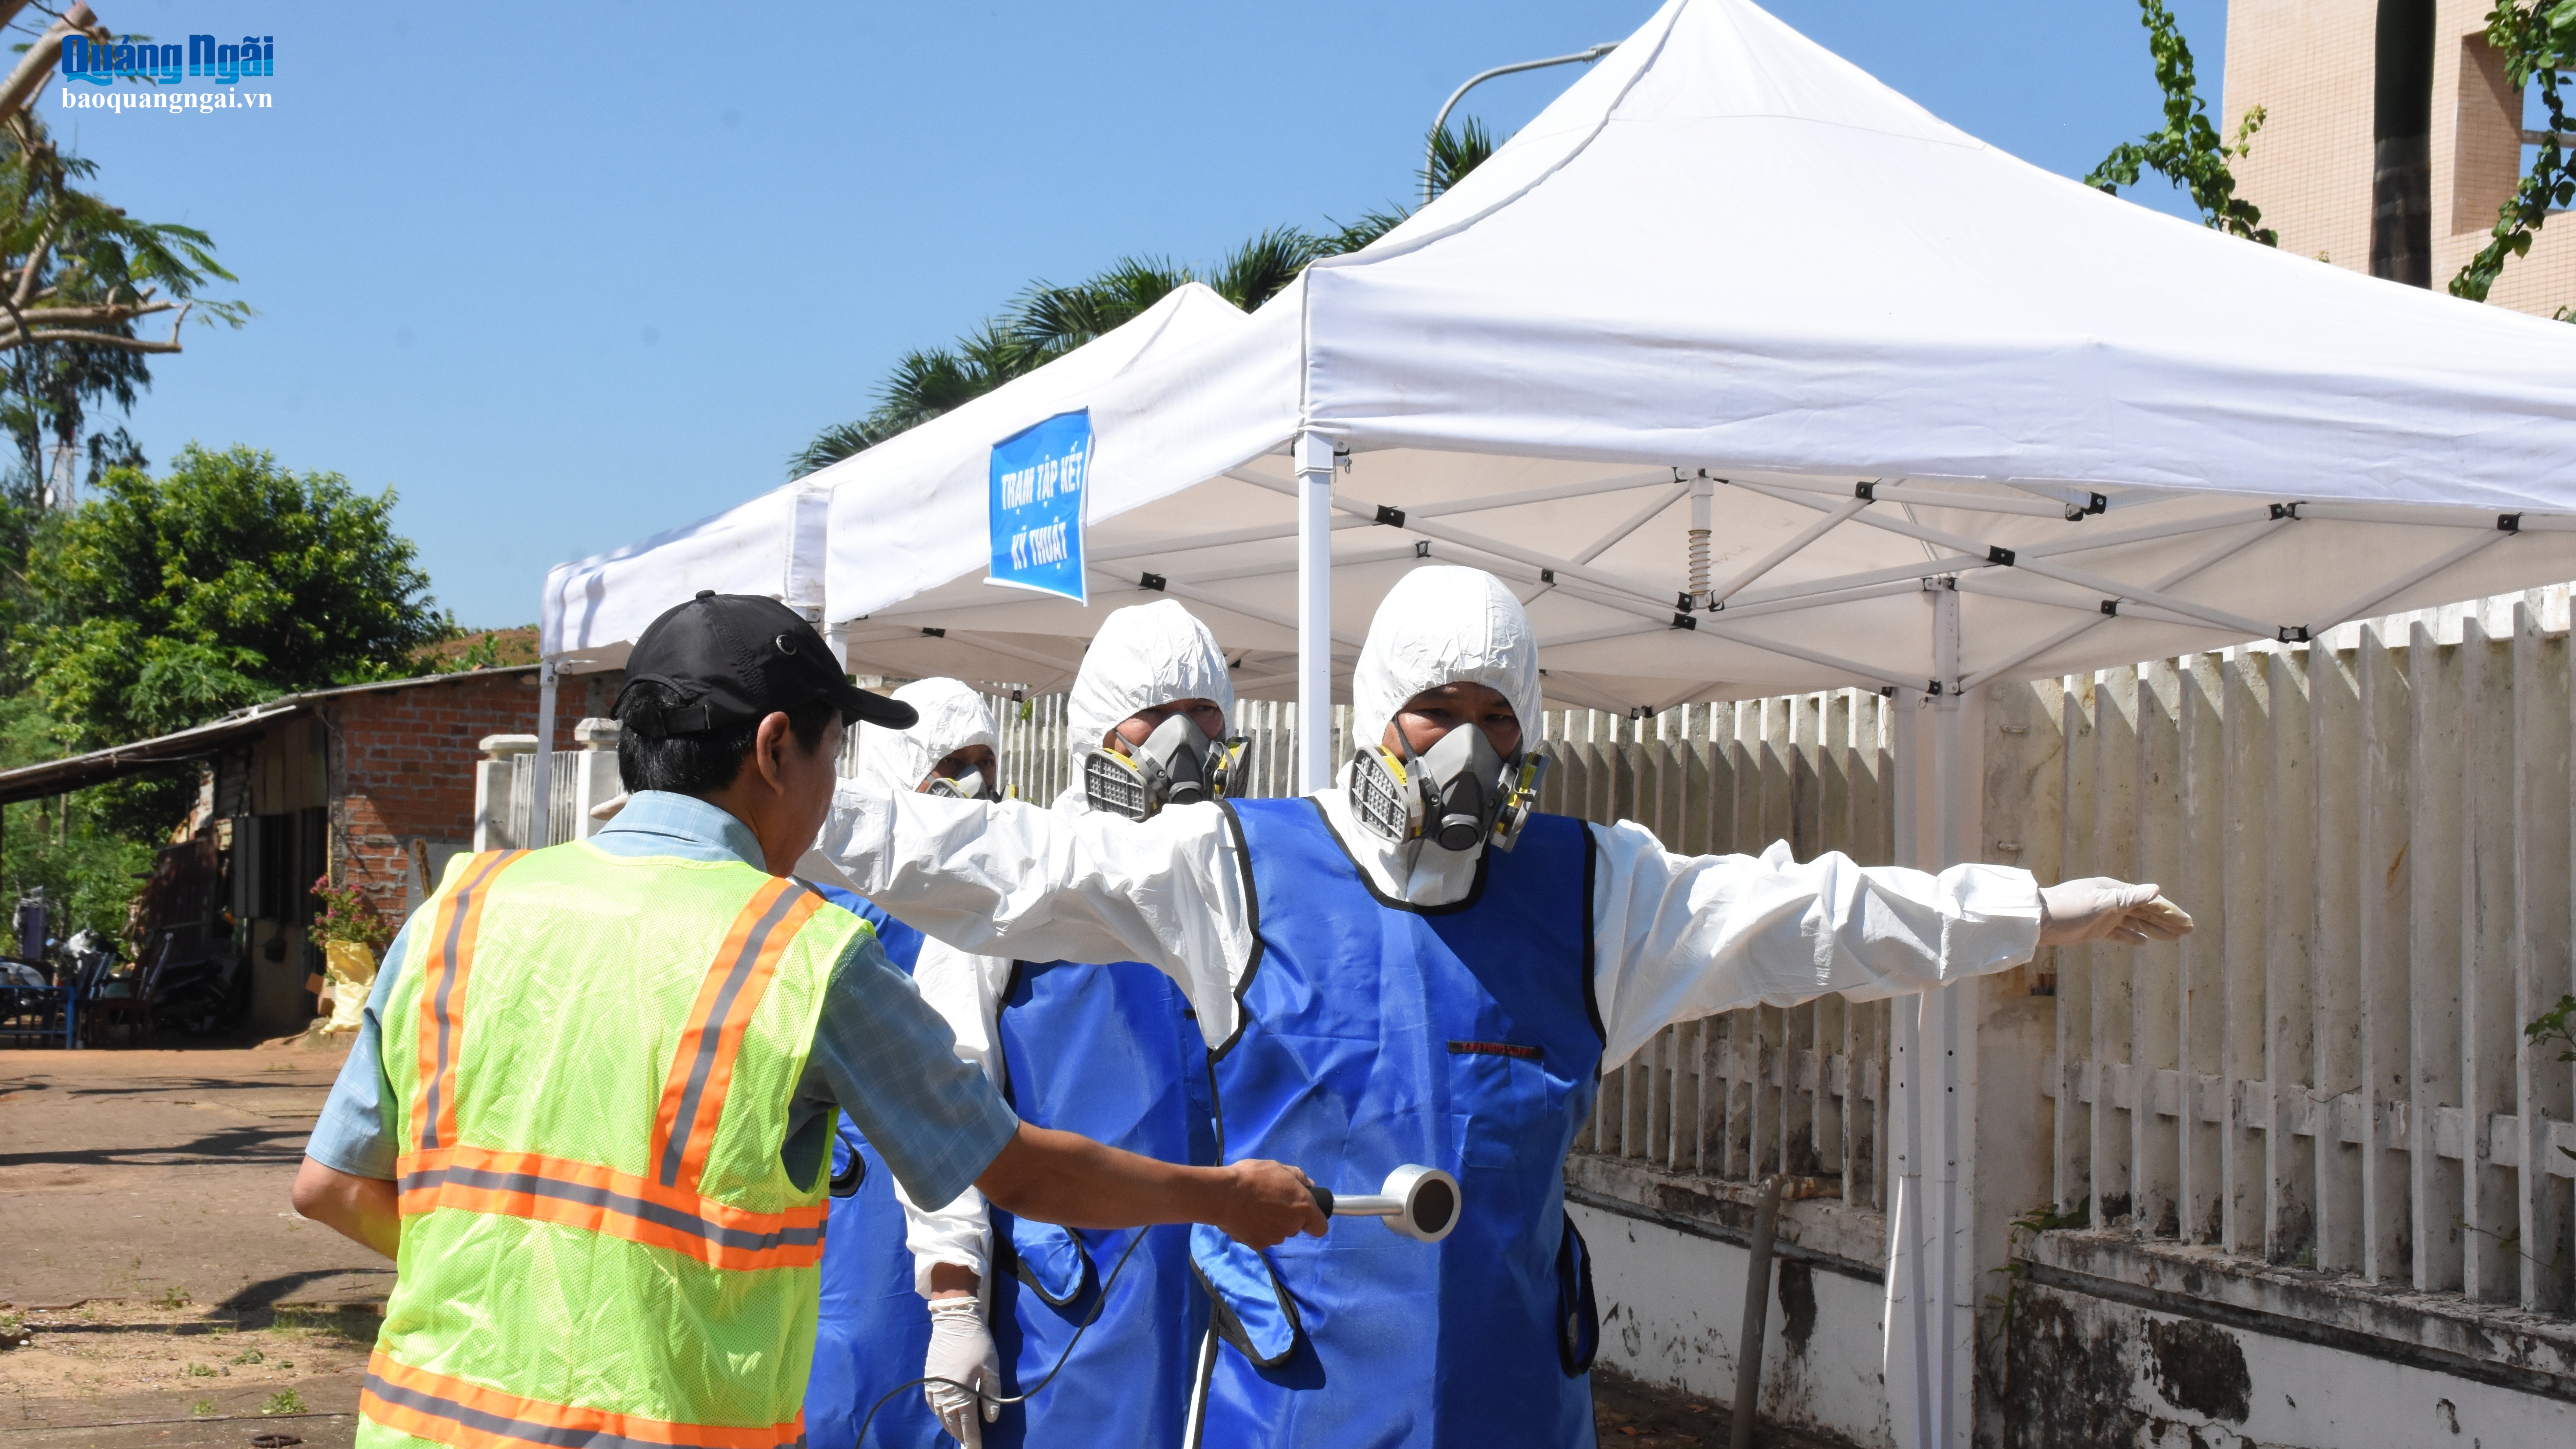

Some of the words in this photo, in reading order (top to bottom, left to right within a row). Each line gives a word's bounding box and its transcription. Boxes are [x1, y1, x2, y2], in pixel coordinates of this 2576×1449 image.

[1002, 467, 1034, 515] TRẠM
[1037, 454, 1058, 507] TẬP
[1061, 441, 1083, 494] KẾT
[1011, 525, 1027, 570] KỸ
[1029, 516, 1067, 569] THUẬT
